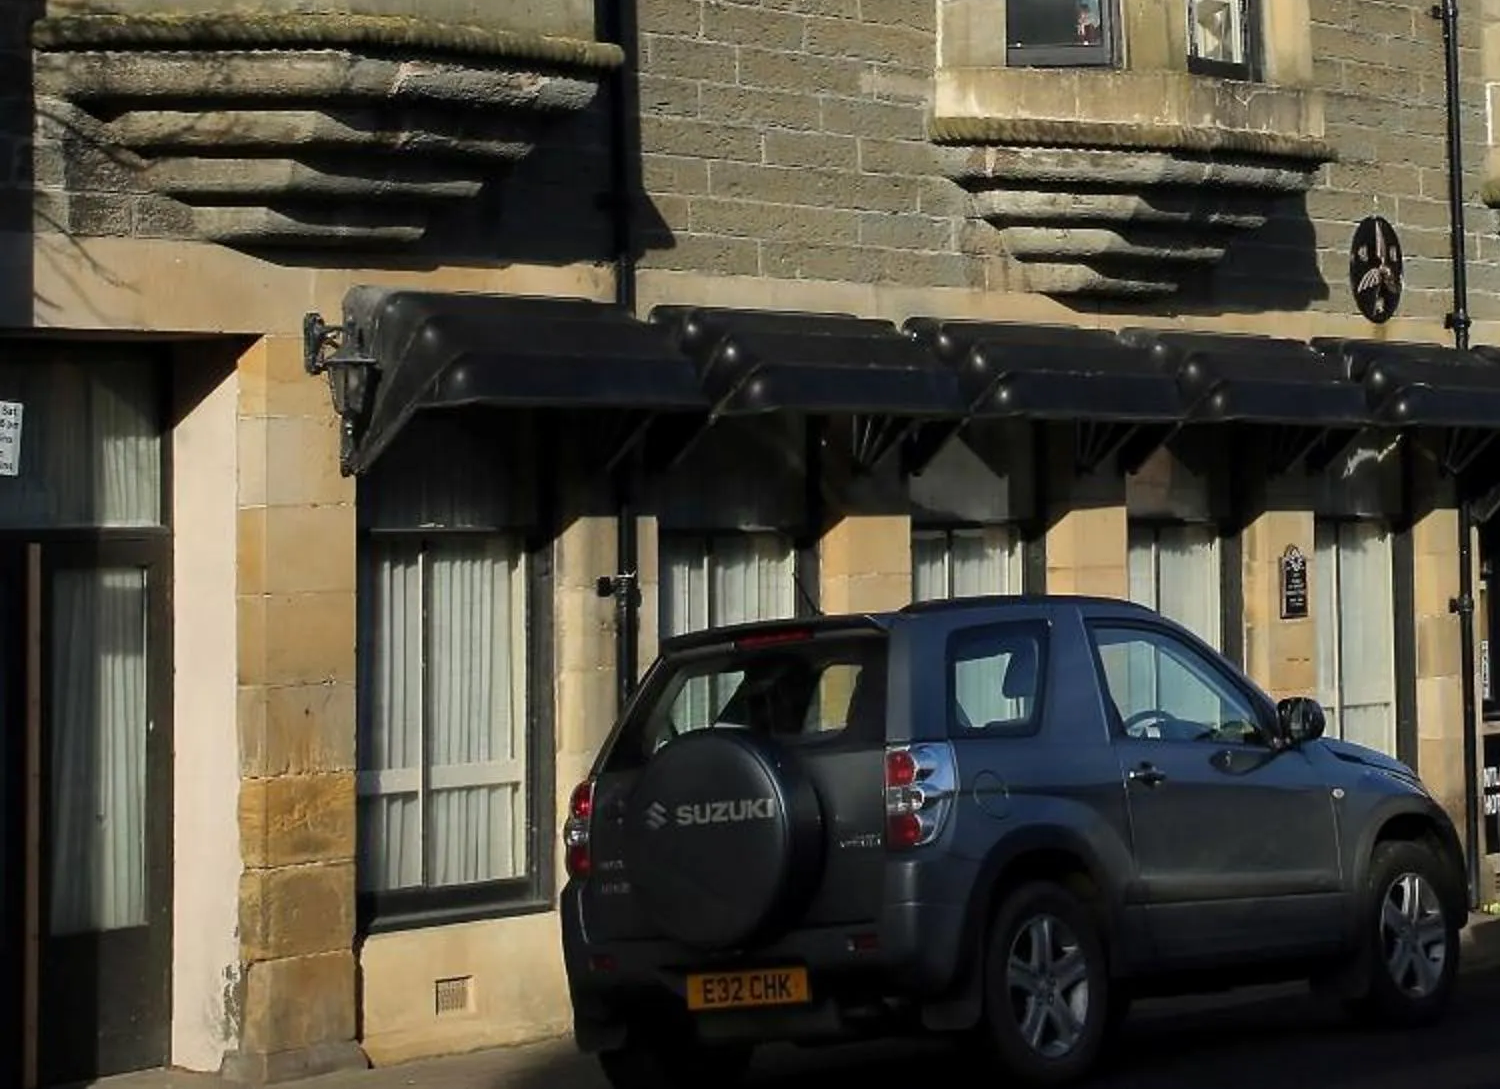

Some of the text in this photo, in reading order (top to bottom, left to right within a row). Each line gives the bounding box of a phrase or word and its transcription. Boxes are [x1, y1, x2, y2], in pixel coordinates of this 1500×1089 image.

[675, 797, 776, 826] SUZUKI
[701, 973, 793, 1004] E32 CHK
